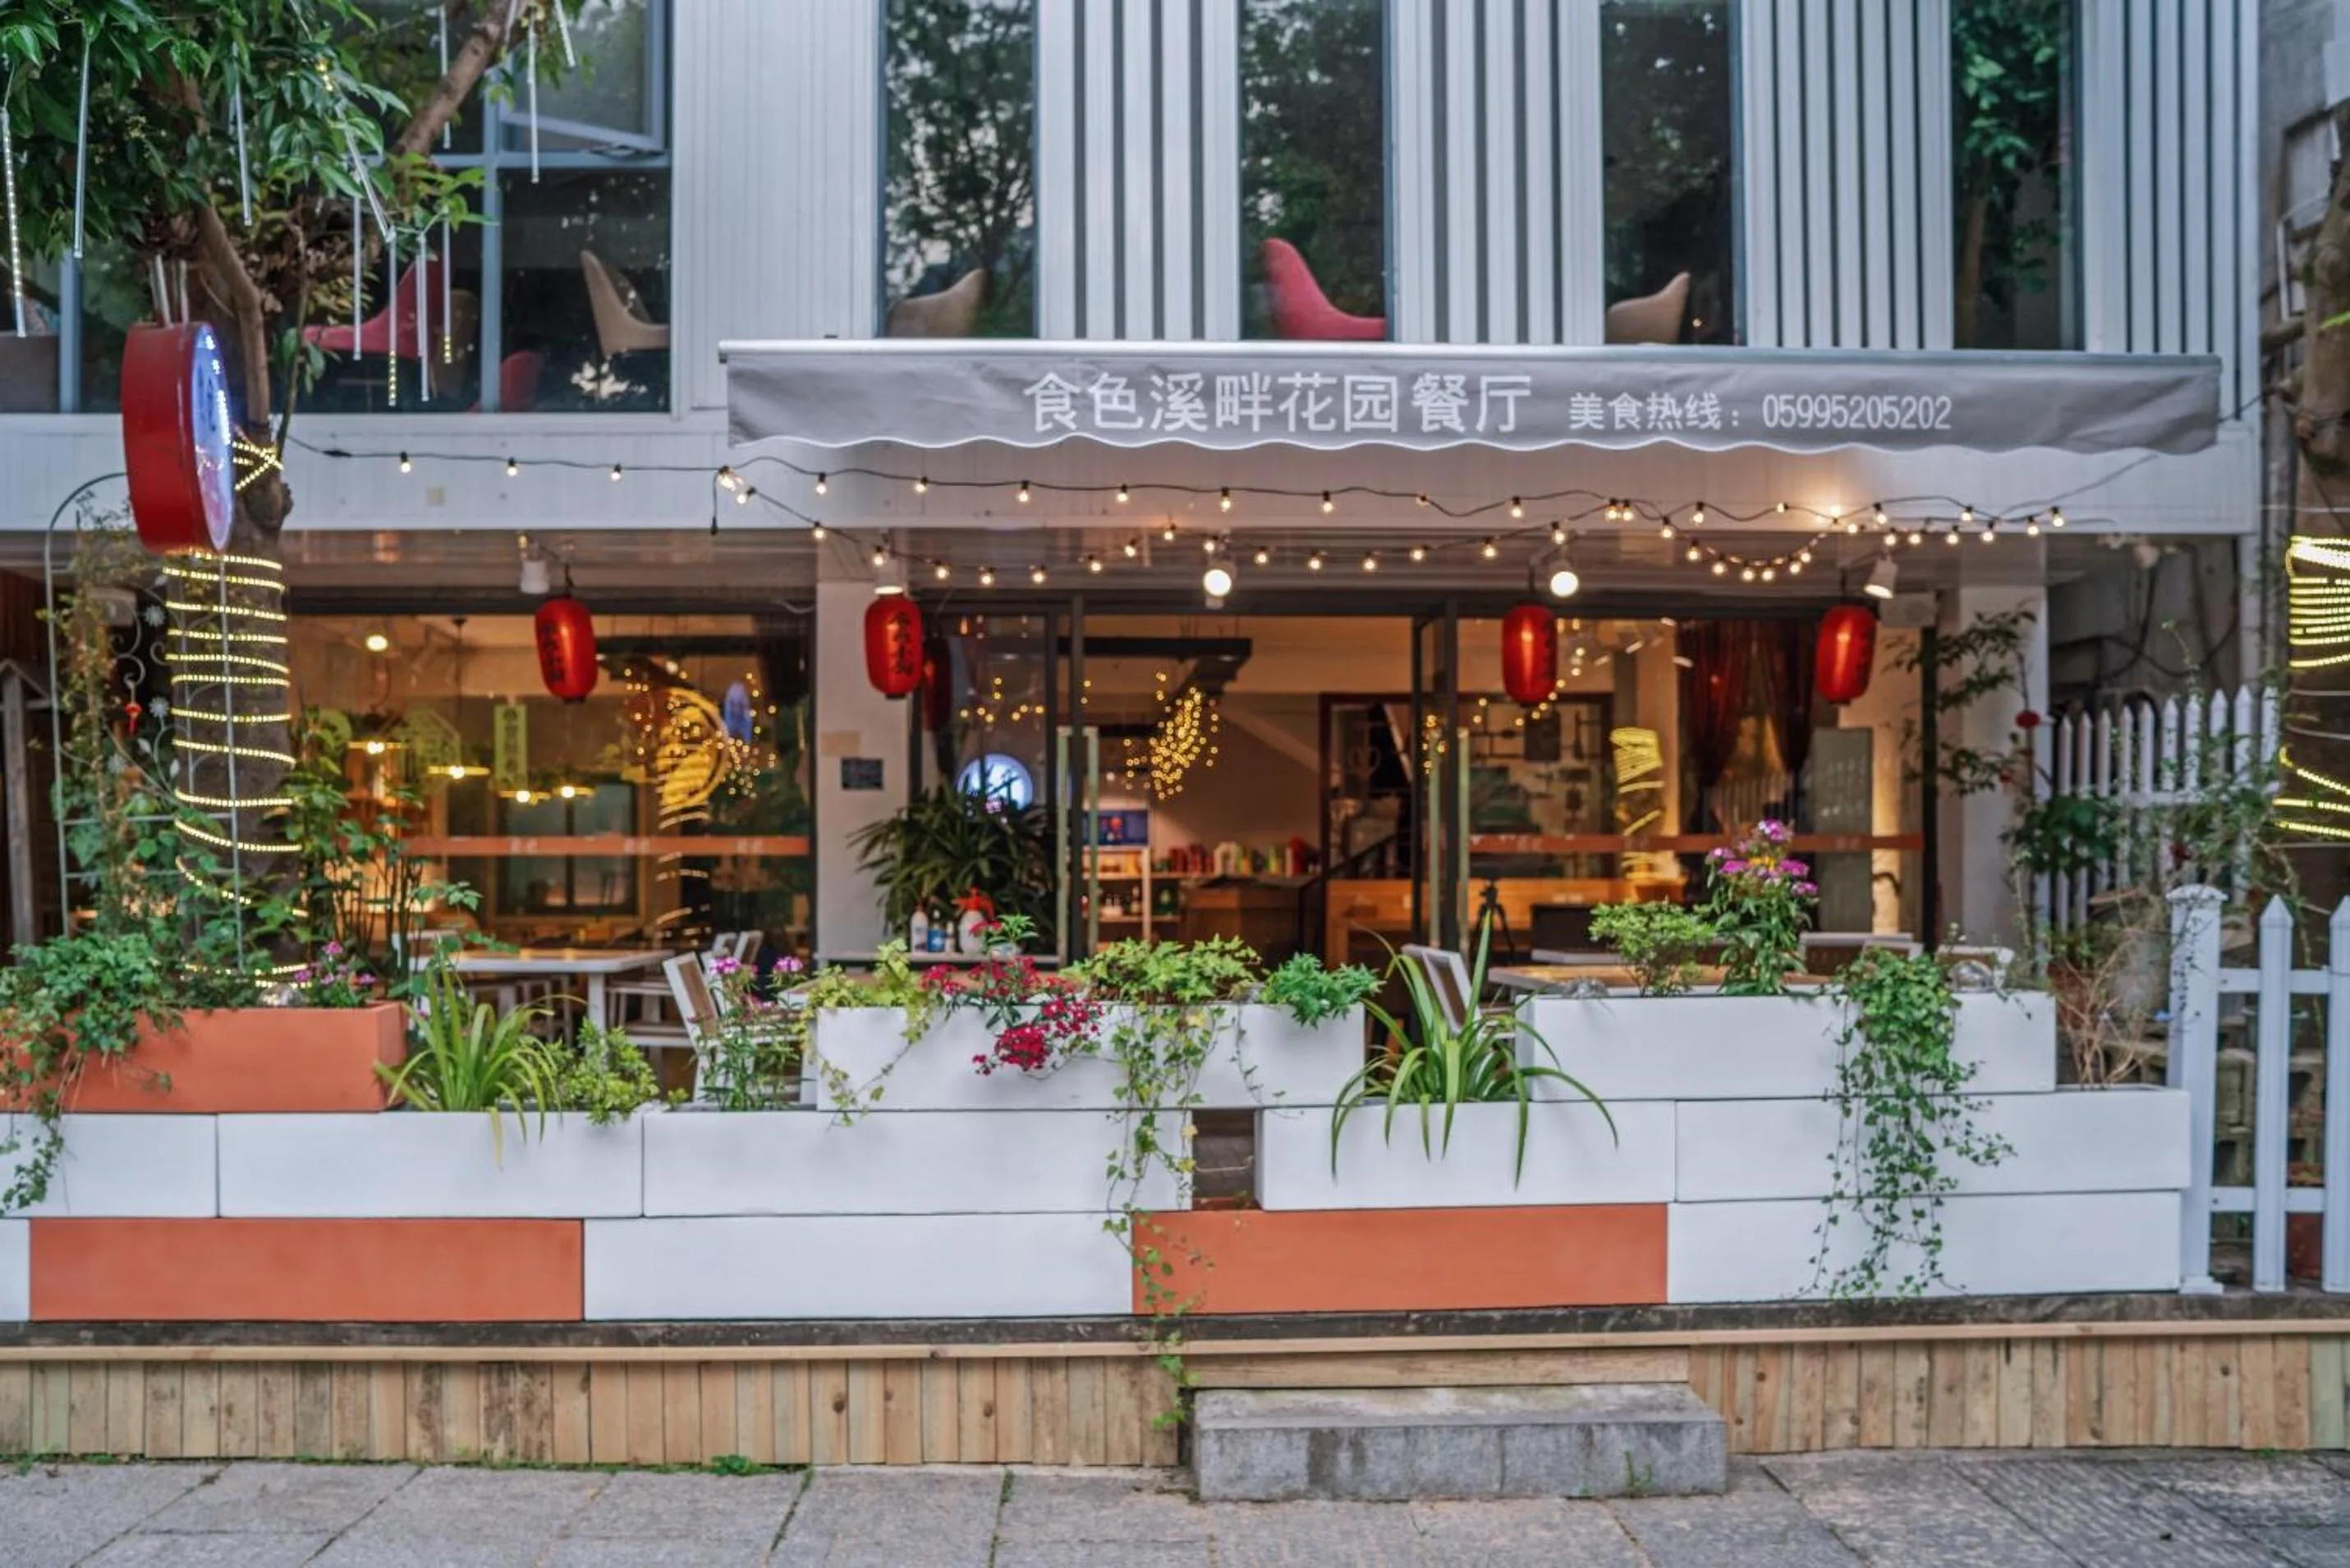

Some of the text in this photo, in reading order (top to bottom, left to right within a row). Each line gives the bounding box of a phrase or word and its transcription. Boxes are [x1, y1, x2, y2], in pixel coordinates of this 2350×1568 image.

[1022, 372, 1531, 433] 食色溪畔花园餐厅
